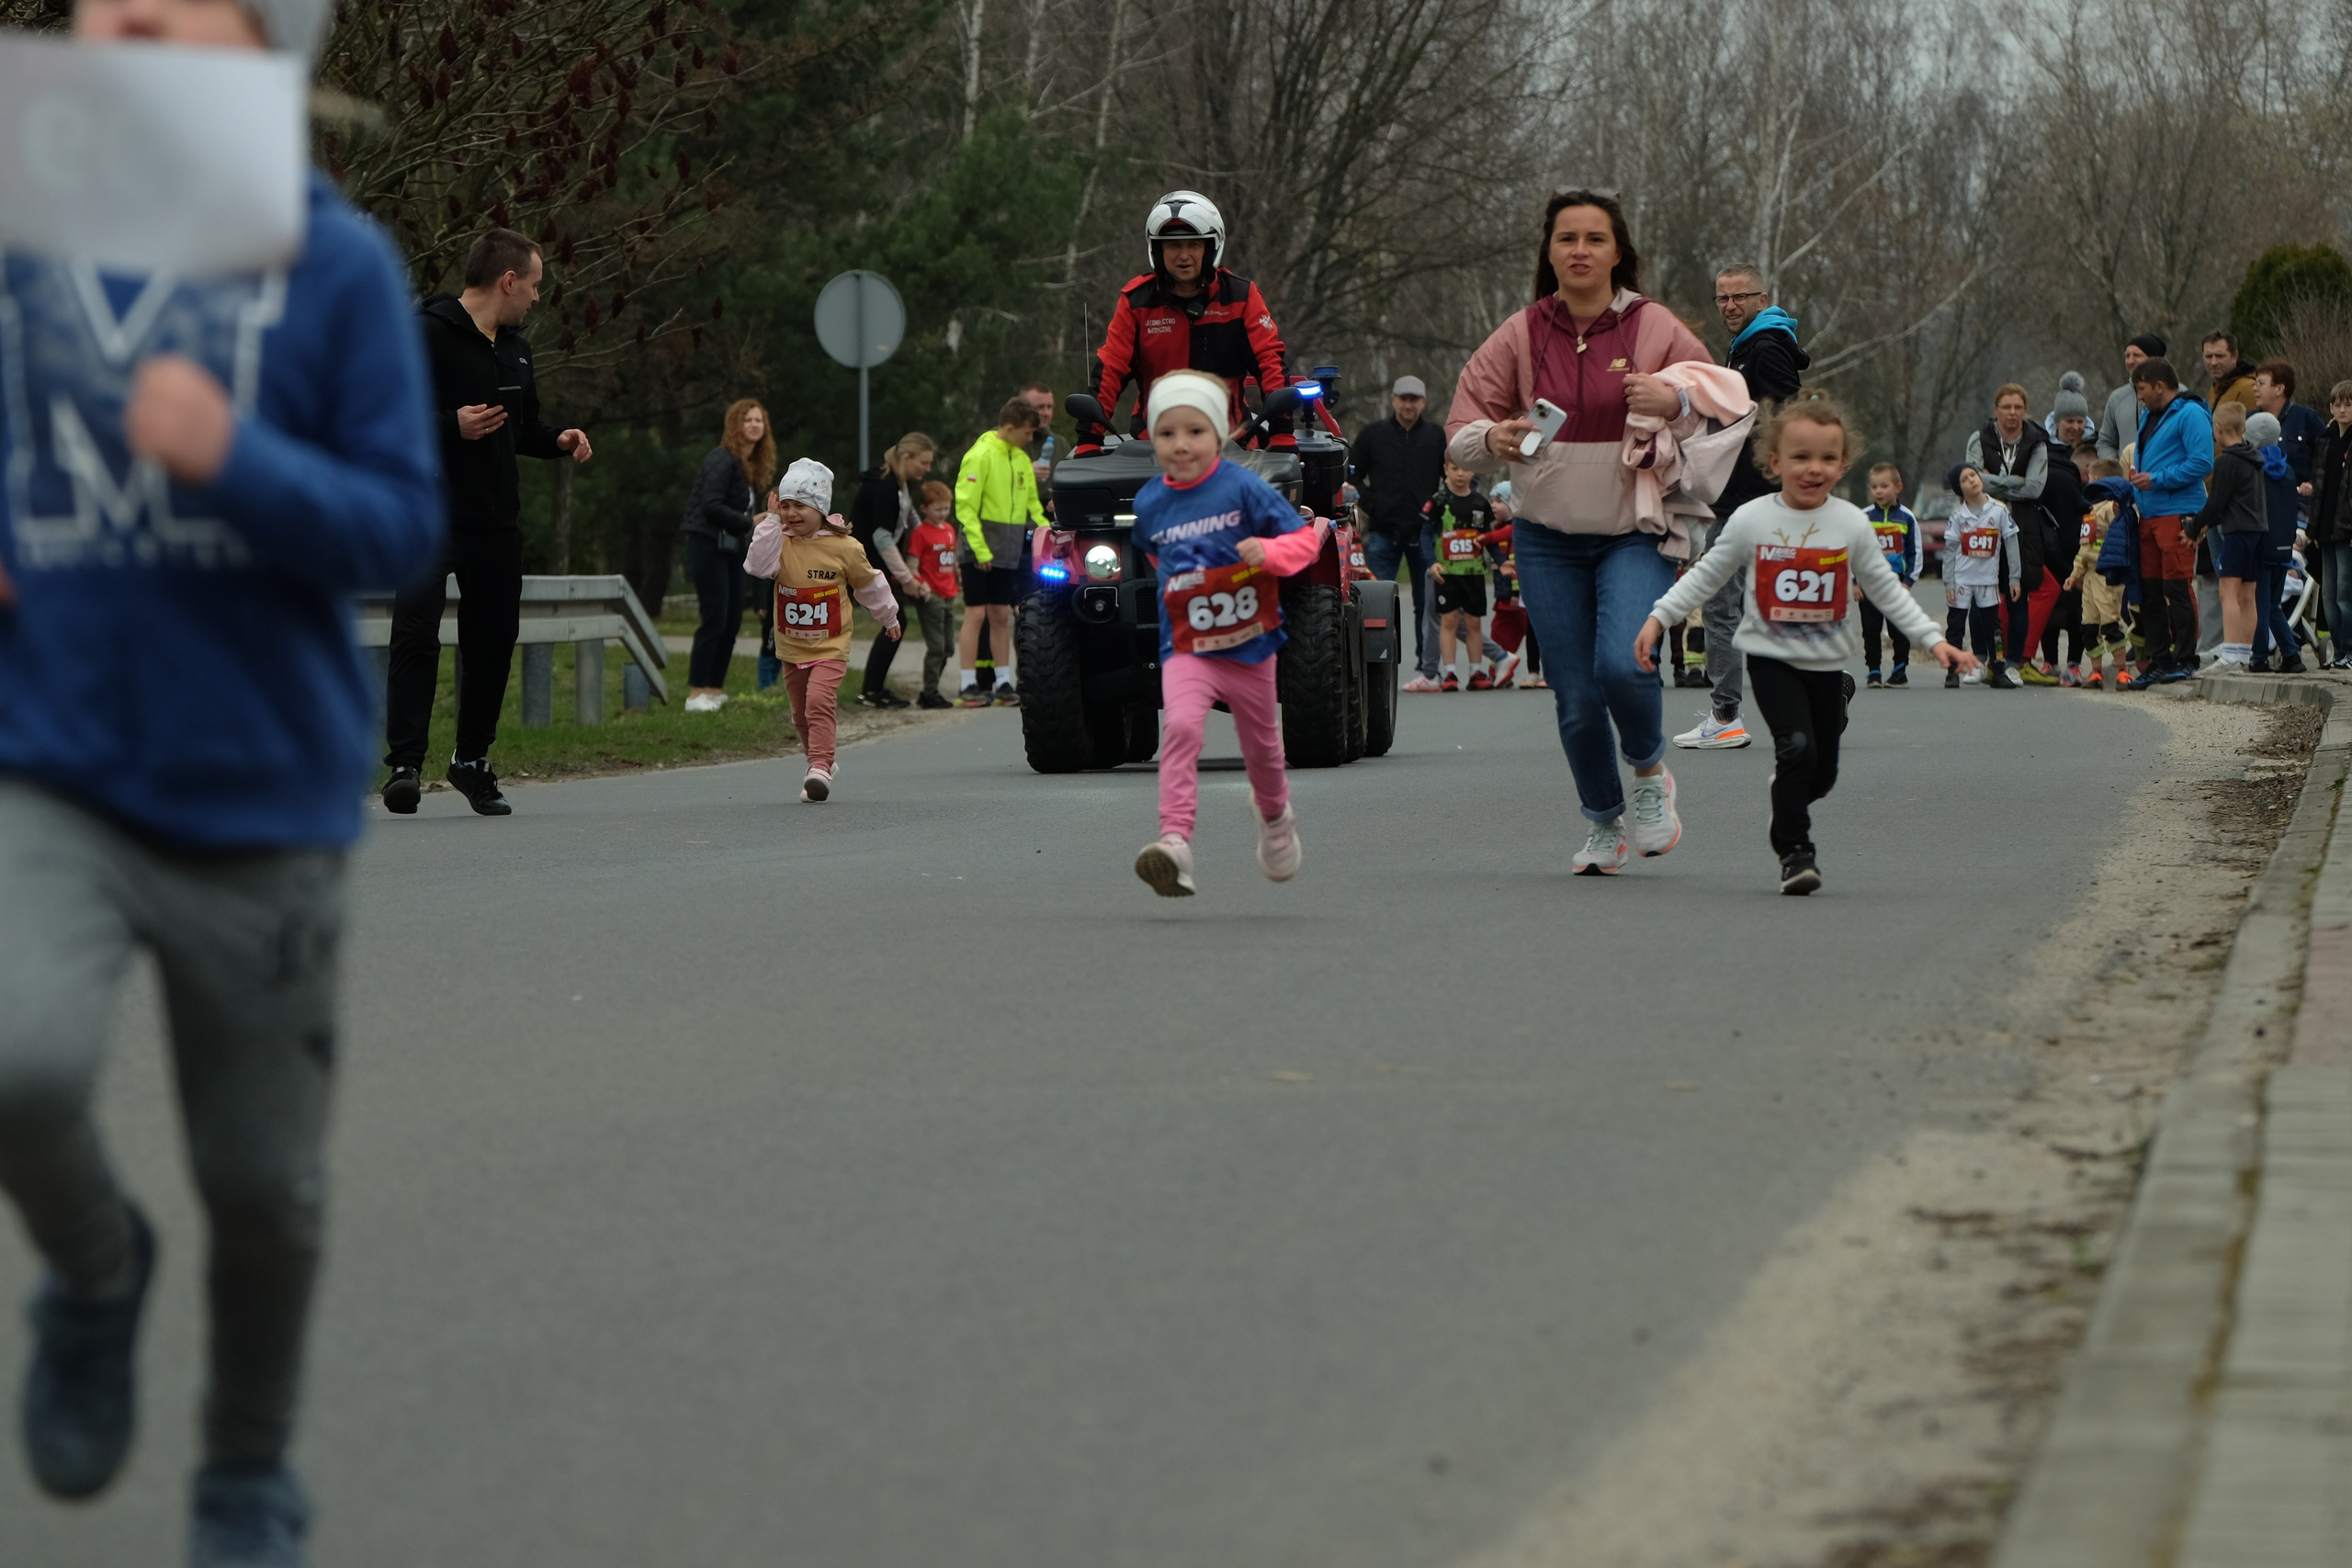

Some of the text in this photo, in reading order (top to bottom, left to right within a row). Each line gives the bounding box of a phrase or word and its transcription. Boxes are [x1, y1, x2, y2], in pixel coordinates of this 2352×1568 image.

[1449, 538, 1474, 554] 615
[1968, 536, 1994, 550] 641
[1774, 569, 1836, 603] 621
[785, 602, 829, 626] 624
[1187, 585, 1259, 631] 628
